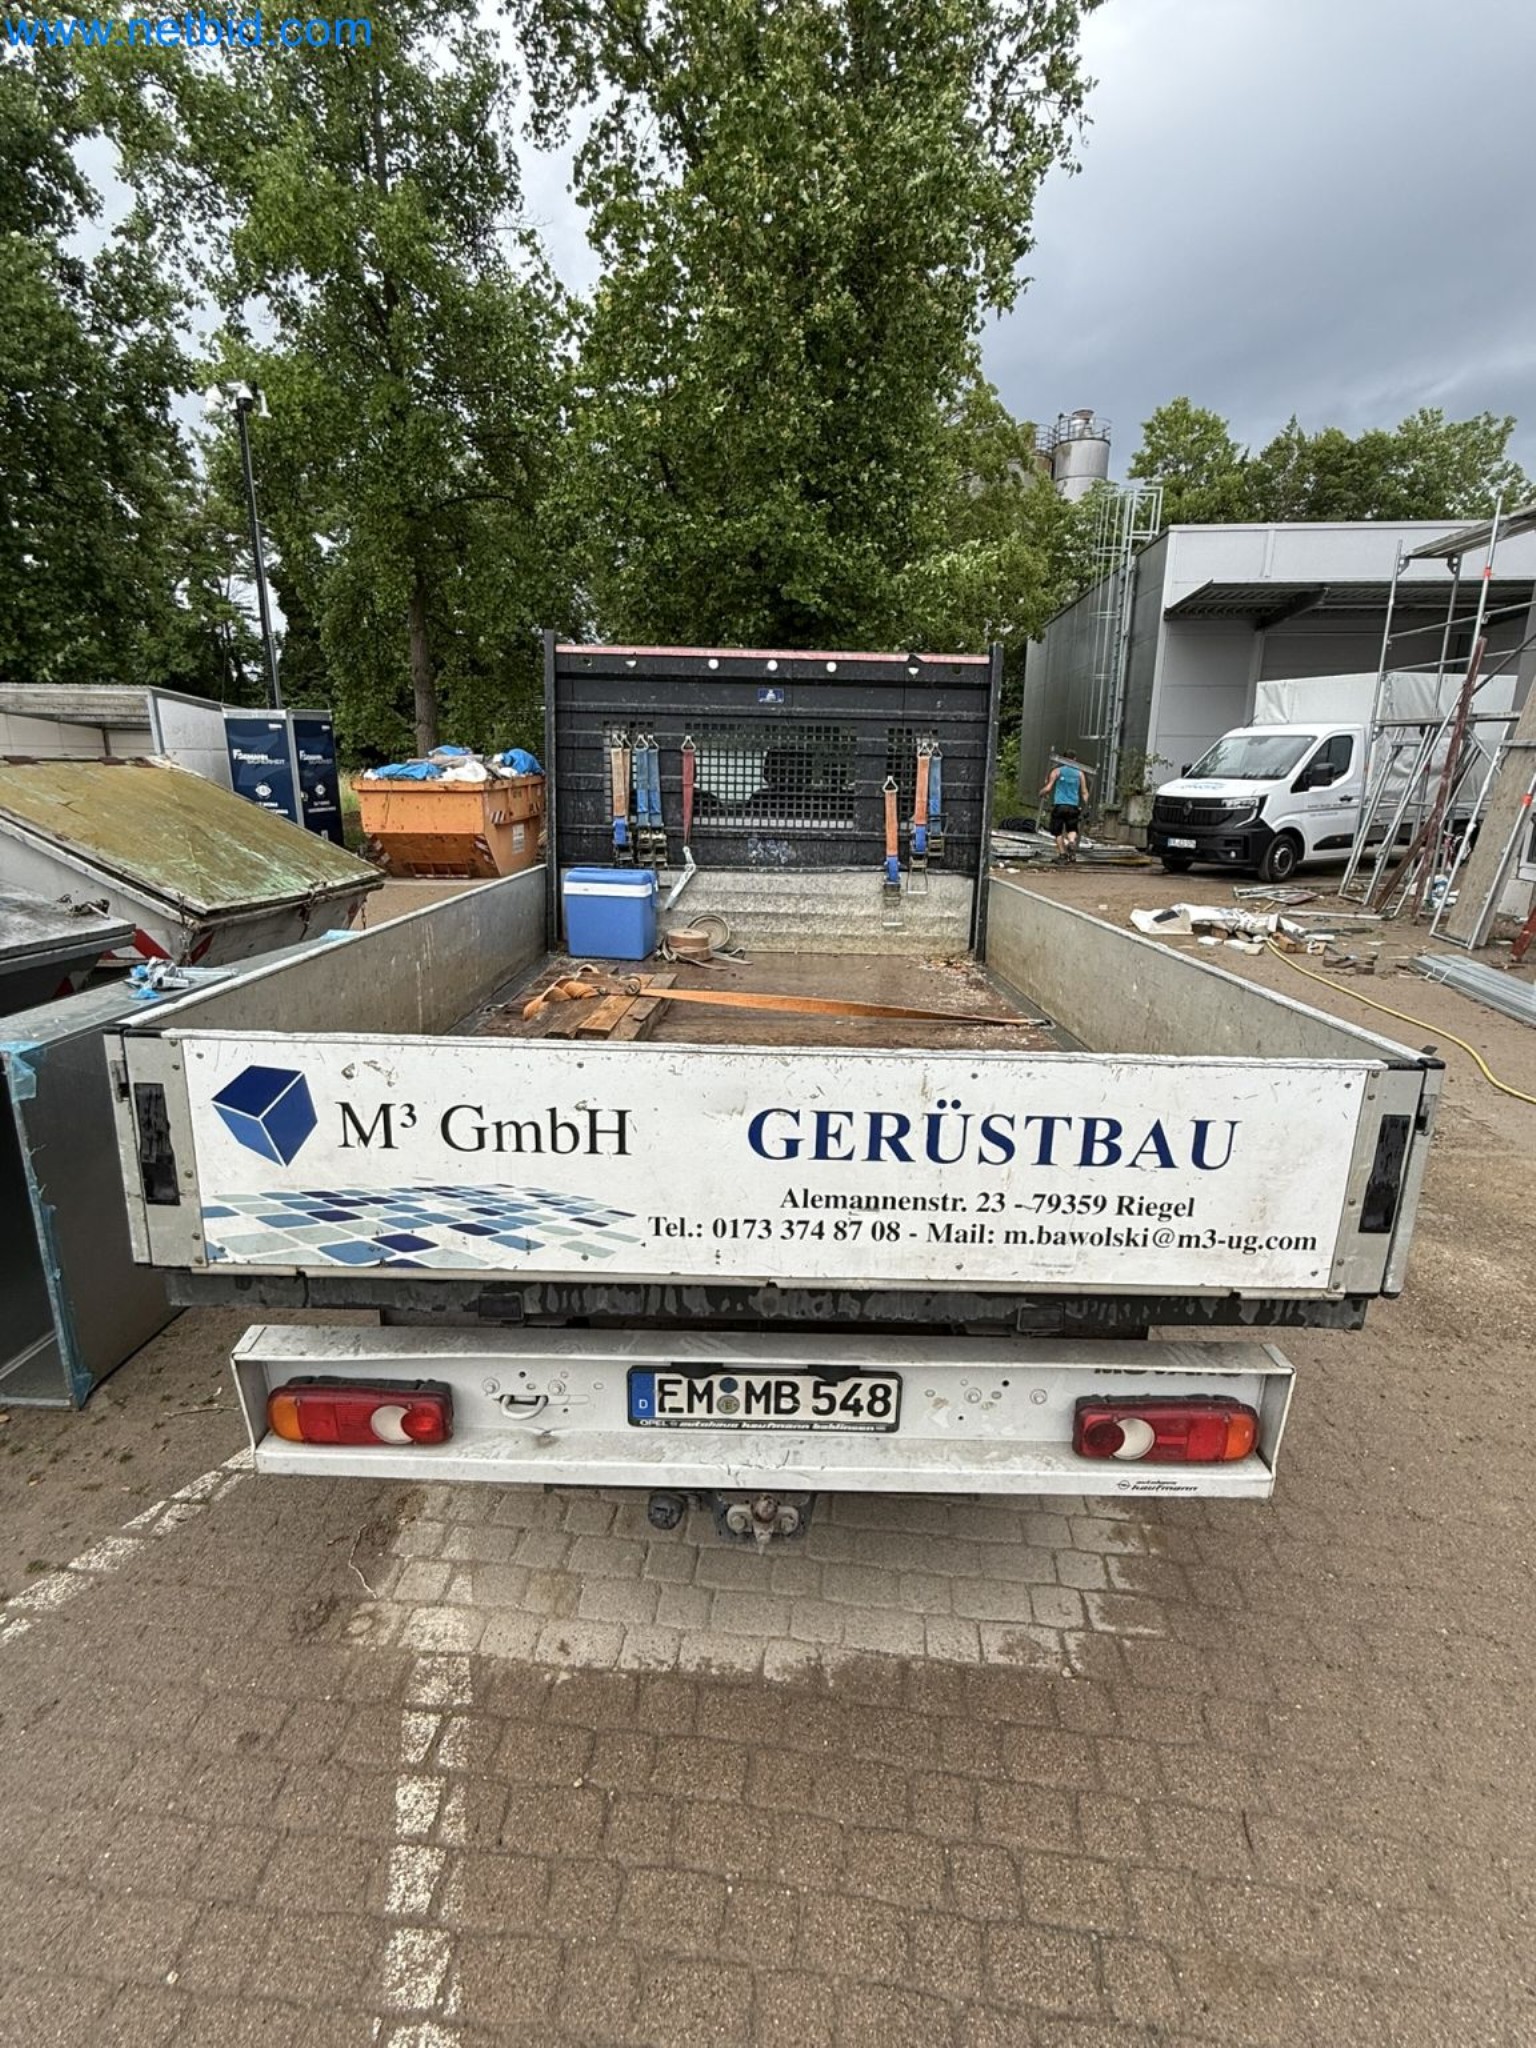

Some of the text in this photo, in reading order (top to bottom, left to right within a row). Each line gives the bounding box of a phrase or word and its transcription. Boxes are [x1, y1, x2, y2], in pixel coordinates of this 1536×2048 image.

[440, 1104, 633, 1156] GmbH
[747, 1098, 1243, 1171] GERÜSTBAU
[779, 1188, 967, 1213] Alemannenstr.
[976, 1192, 1005, 1213] 23
[1032, 1193, 1108, 1215] 79359
[1115, 1195, 1196, 1222] Riegel
[648, 1216, 703, 1238] Tel.:
[712, 1218, 773, 1240] 0173
[780, 1219, 826, 1241] 374
[832, 1221, 863, 1242] 87
[870, 1221, 901, 1242] 08
[926, 1223, 995, 1245] Mail:
[1003, 1226, 1318, 1255] m.bawolski@m3-ug.com
[639, 1399, 649, 1409] D
[657, 1379, 893, 1418] EM MB 548
